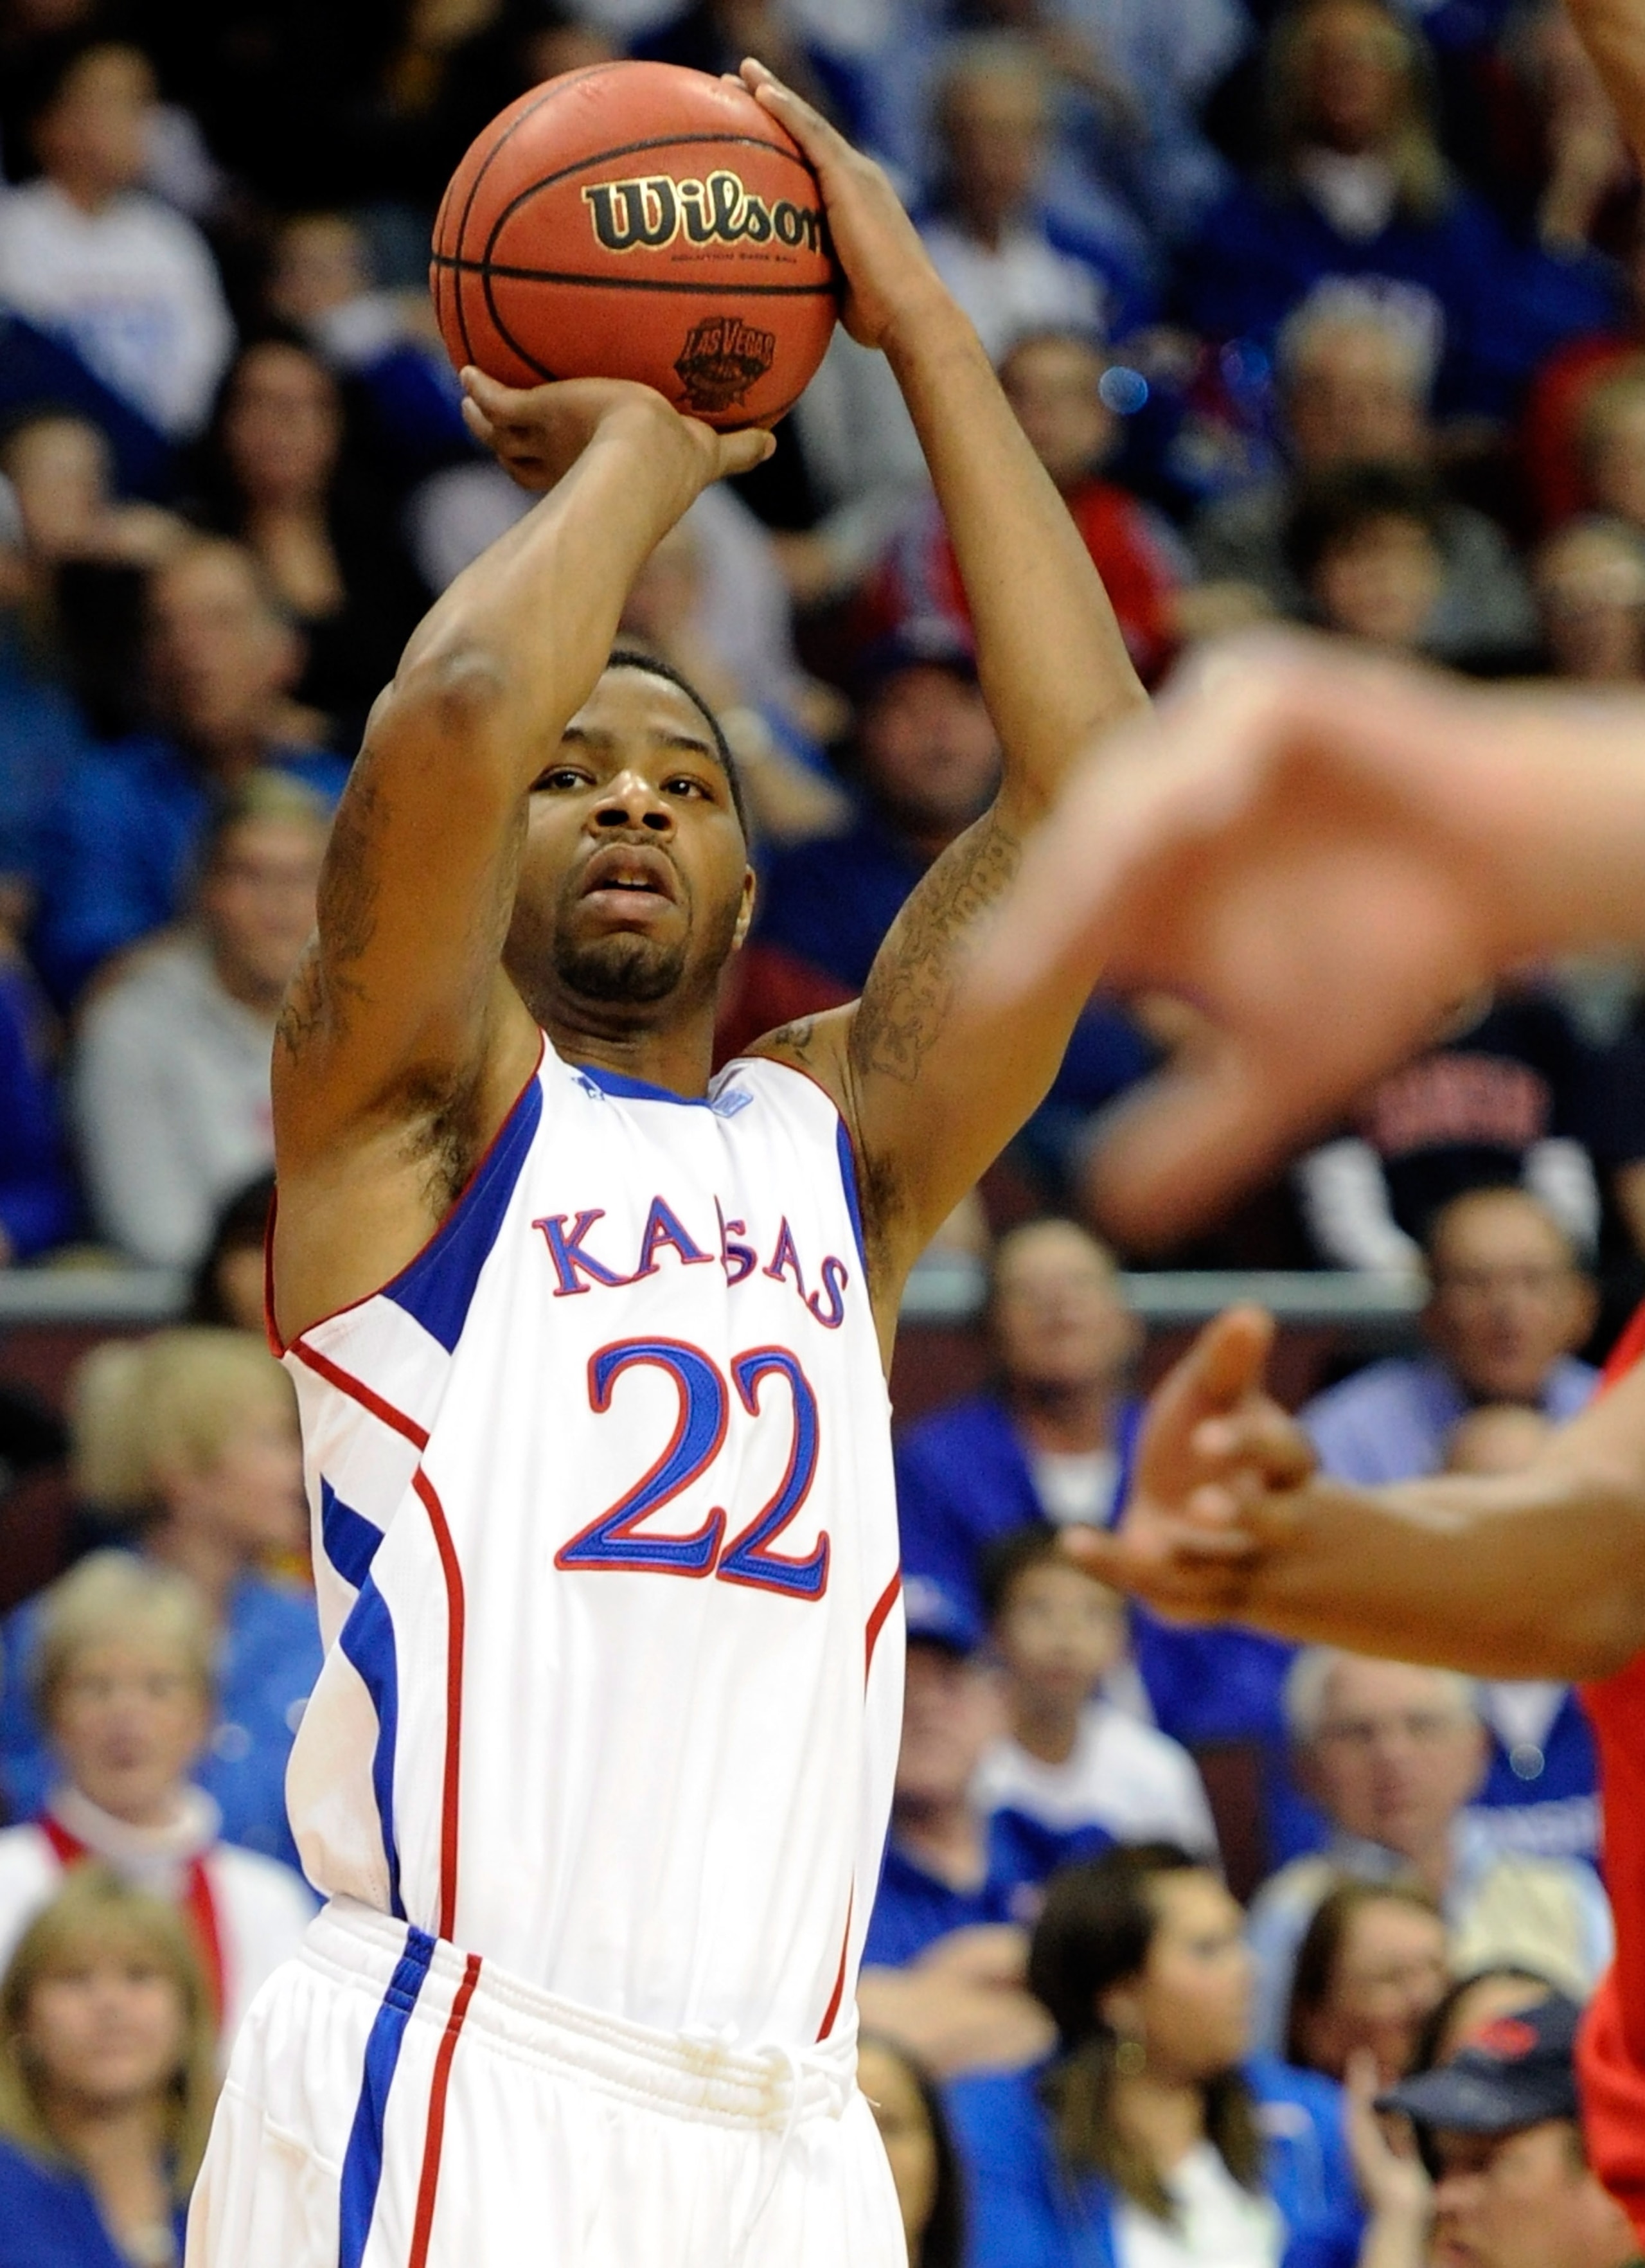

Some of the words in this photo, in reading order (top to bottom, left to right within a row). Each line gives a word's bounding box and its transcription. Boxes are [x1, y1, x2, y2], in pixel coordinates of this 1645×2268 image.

[582, 170, 823, 254] Wilson
[681, 328, 721, 361] LAS
[721, 320, 774, 366] VEGAS
[532, 1194, 848, 1328] KASAS
[554, 1336, 830, 1601] 22
